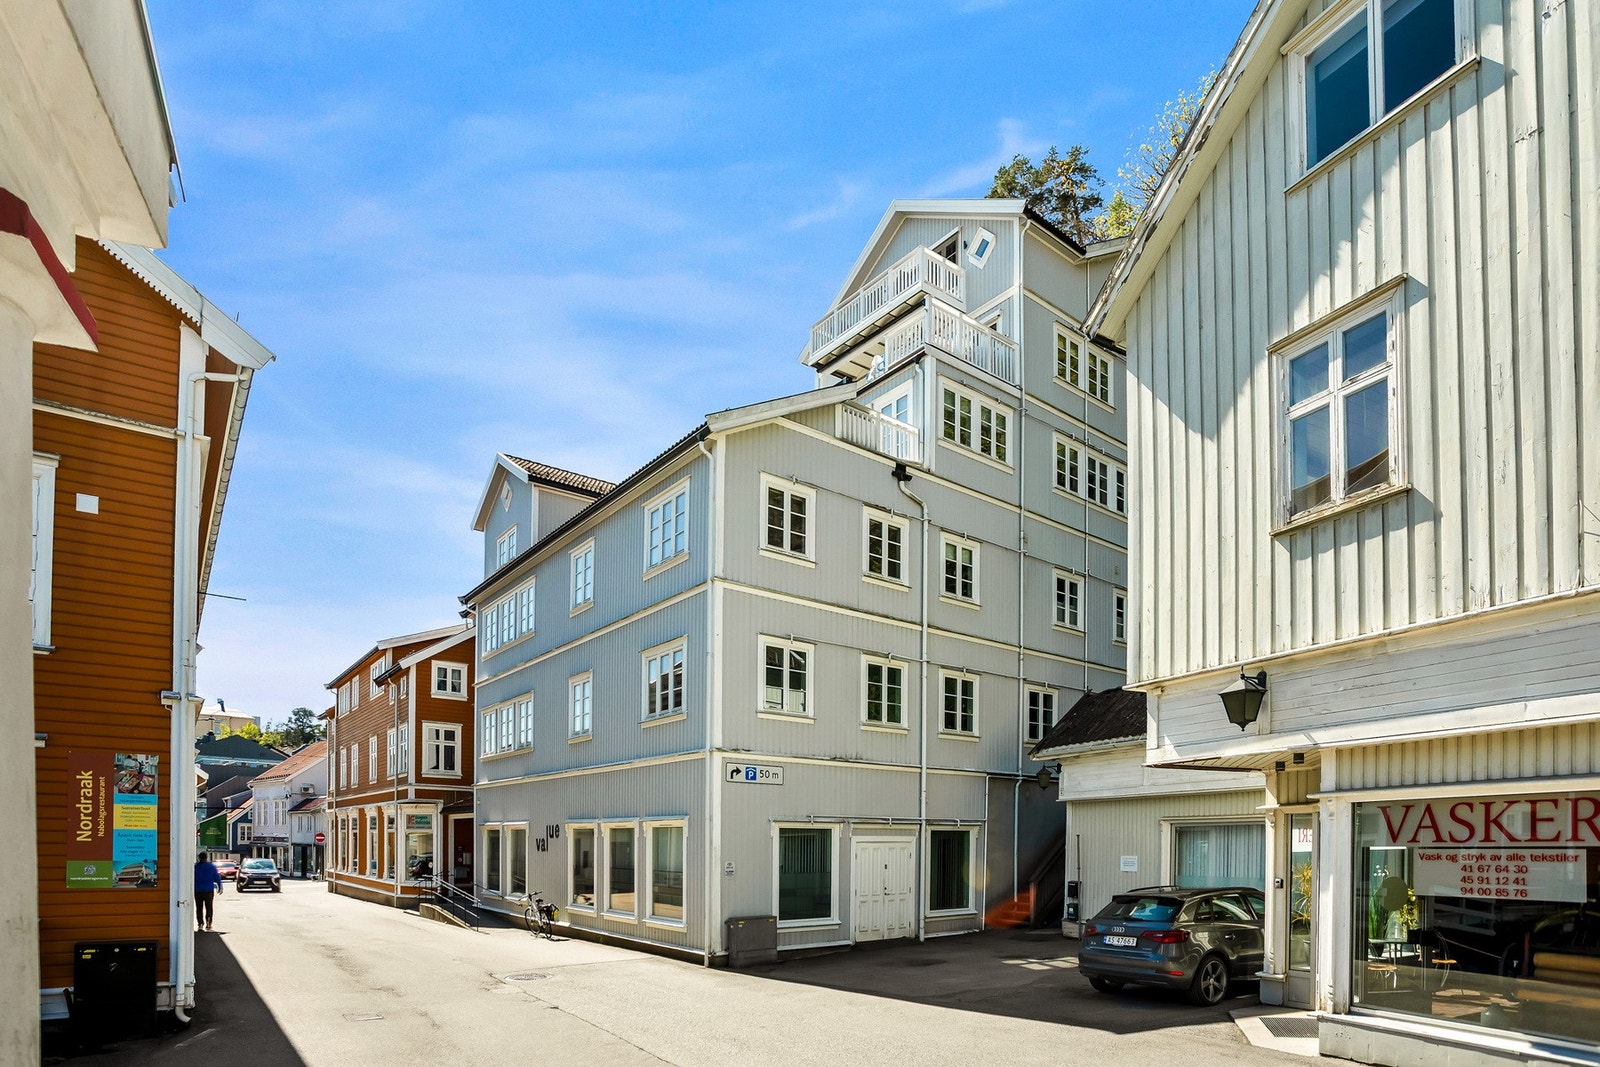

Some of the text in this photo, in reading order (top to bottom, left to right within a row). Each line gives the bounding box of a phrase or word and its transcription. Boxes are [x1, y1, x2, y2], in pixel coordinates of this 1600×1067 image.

[759, 769, 771, 779] 50
[76, 770, 93, 842] Nordraak
[98, 776, 108, 837] Nabolagsrestaurant
[1376, 796, 1600, 844] VASKER
[535, 823, 560, 852] value
[1418, 852, 1580, 863] Vask og stryk av alle tekstiler
[1460, 864, 1528, 874] 41 67 64 30
[1460, 876, 1527, 886] 45 91 12 41
[1460, 887, 1528, 898] 94 00 85 76
